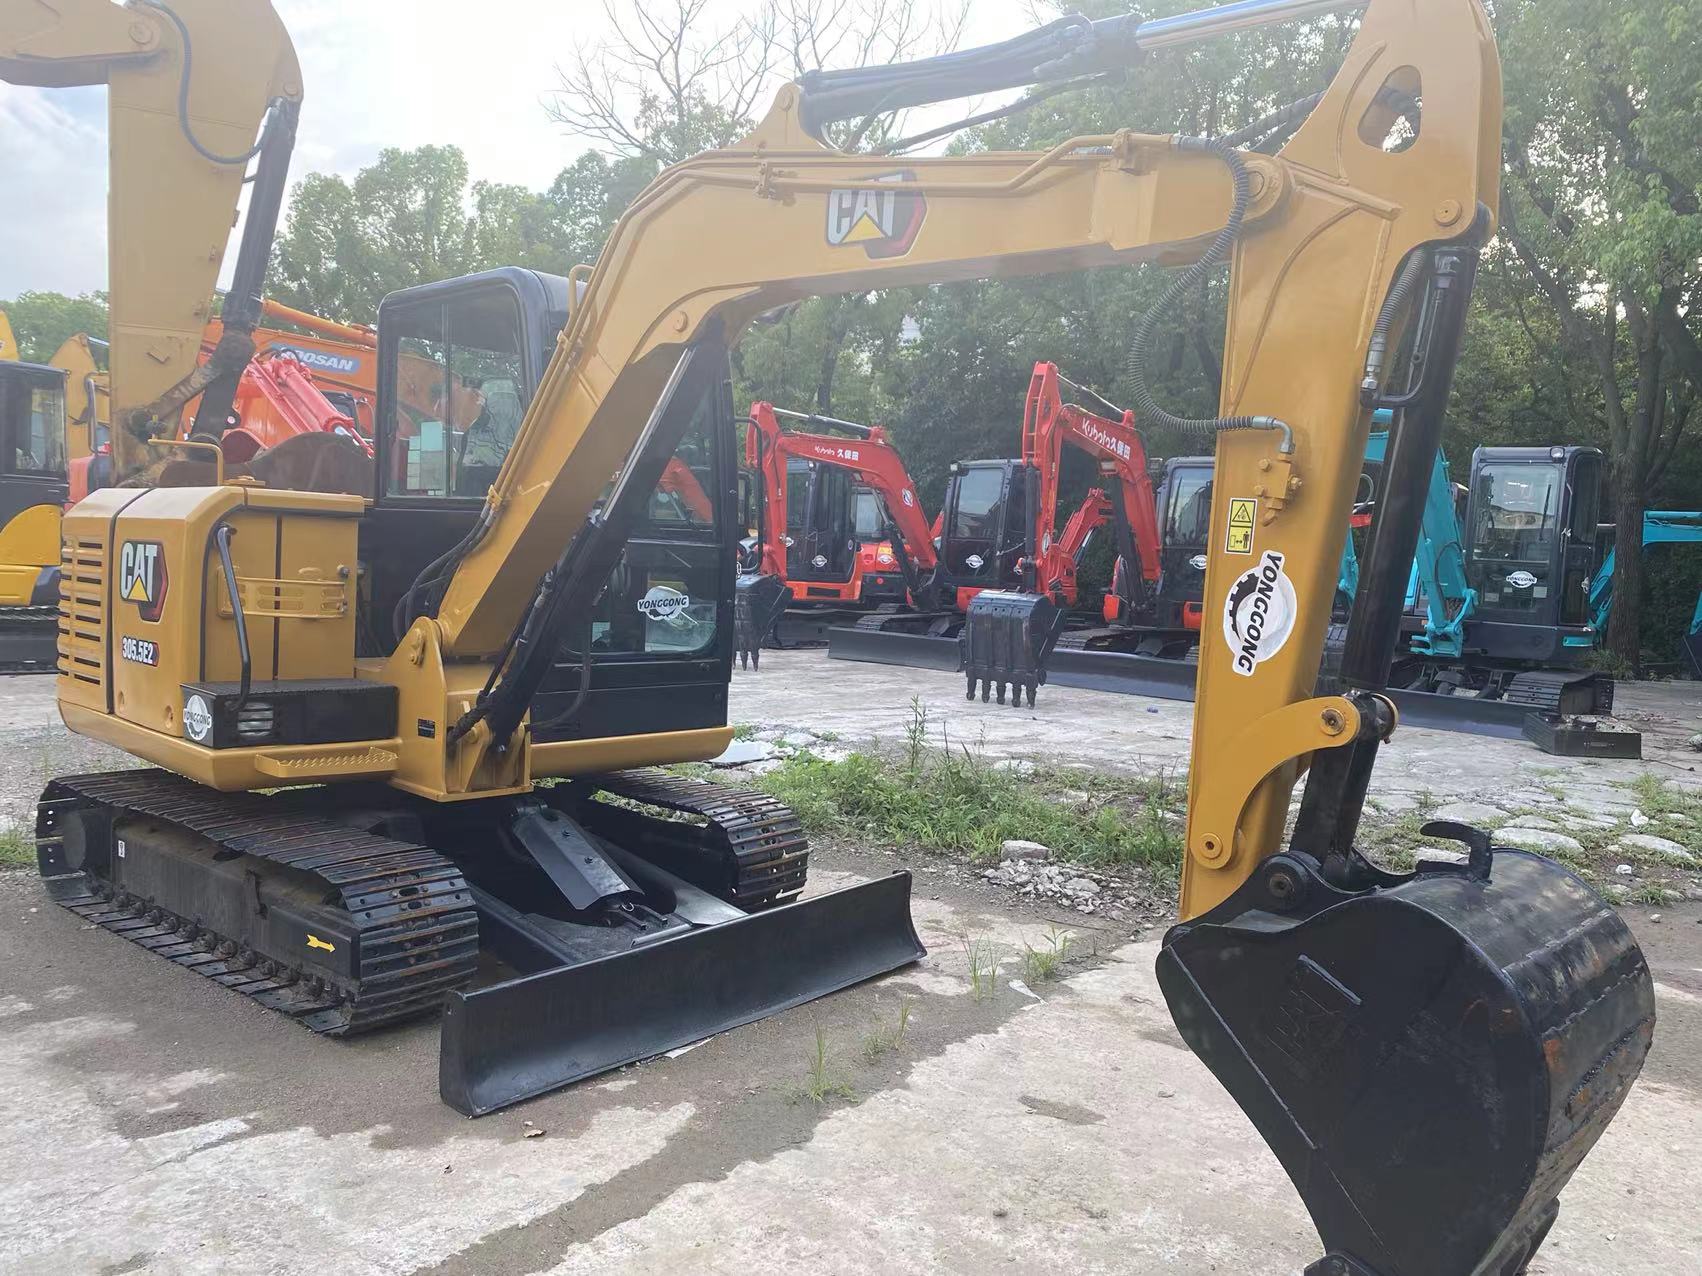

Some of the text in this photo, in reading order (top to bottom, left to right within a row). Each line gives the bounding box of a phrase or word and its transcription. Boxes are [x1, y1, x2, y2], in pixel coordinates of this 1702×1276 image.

[828, 173, 903, 245] CAT
[836, 447, 860, 461] 久保田
[1110, 436, 1132, 463] 久保田
[120, 541, 158, 602] CAT
[121, 636, 155, 666] 305.5E2
